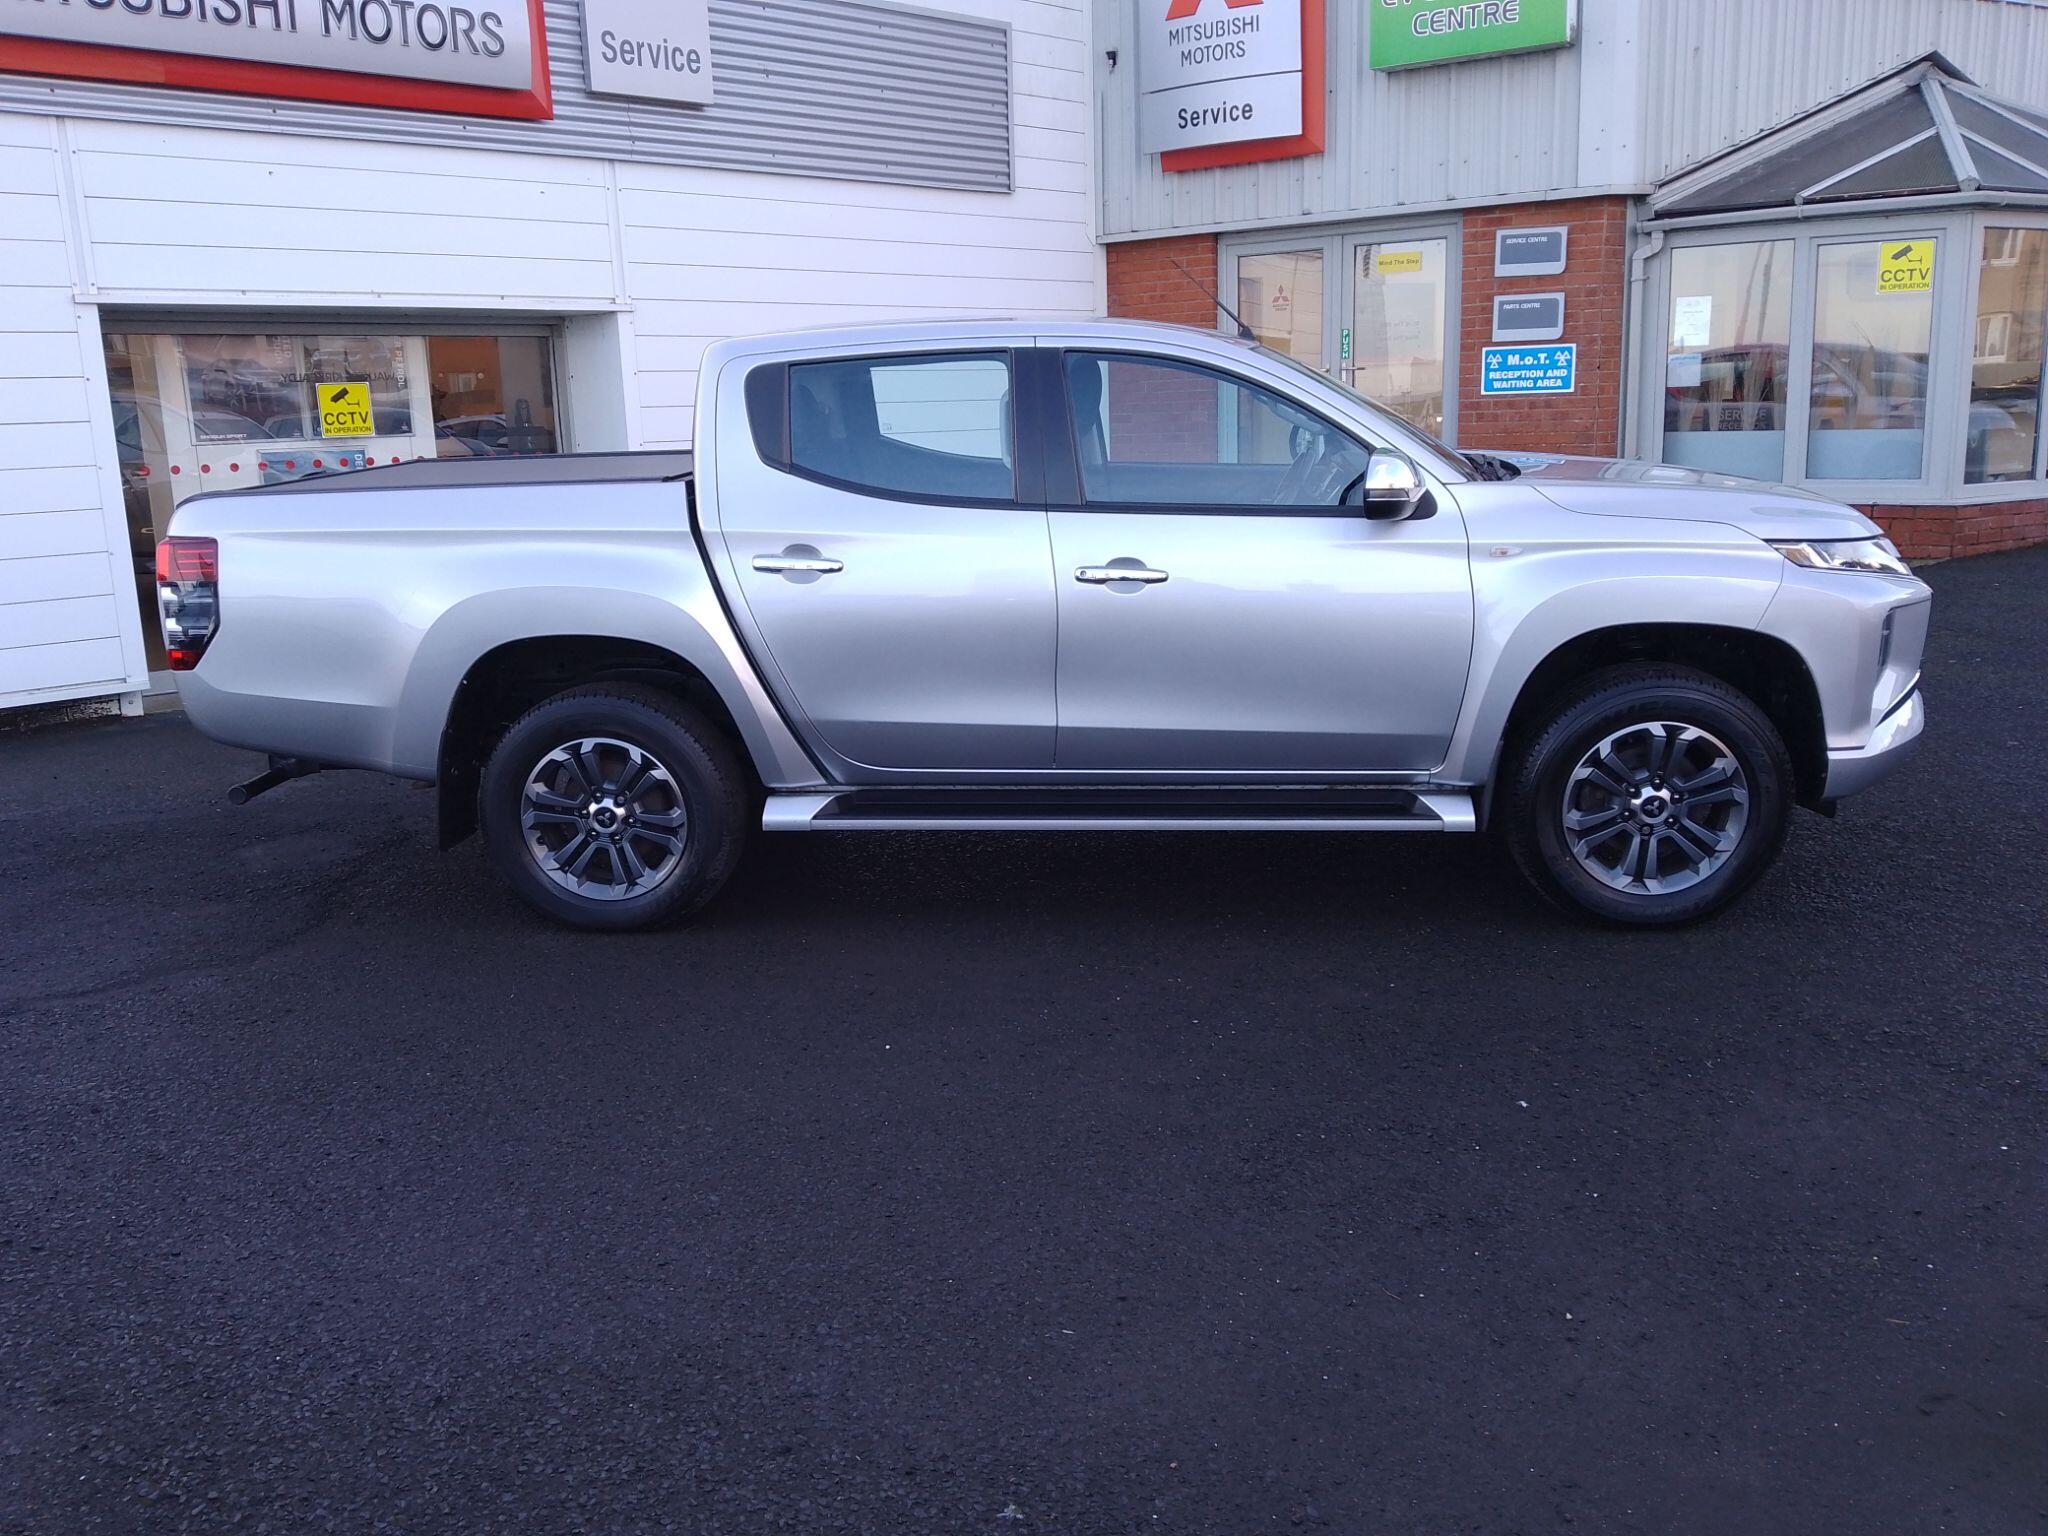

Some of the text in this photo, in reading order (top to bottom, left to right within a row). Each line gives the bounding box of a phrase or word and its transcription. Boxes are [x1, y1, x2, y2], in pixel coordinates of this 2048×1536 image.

[321, 0, 505, 57] MOTORS
[1412, 0, 1519, 36] CENTRE
[1169, 14, 1260, 47] MITSUBISHI
[601, 29, 702, 75] Service
[1181, 40, 1246, 67] MOTORS
[1178, 101, 1253, 130] Service
[1881, 267, 1930, 283] CCTV
[1888, 282, 1930, 290] OPERATION
[1341, 329, 1349, 359] PUSH
[1507, 353, 1550, 366] M.o.T.
[1489, 368, 1568, 380] RECEPTION AND
[1493, 378, 1563, 389] WAITING AREA
[324, 411, 369, 426] CCTV
[333, 425, 372, 434] OPERATION
